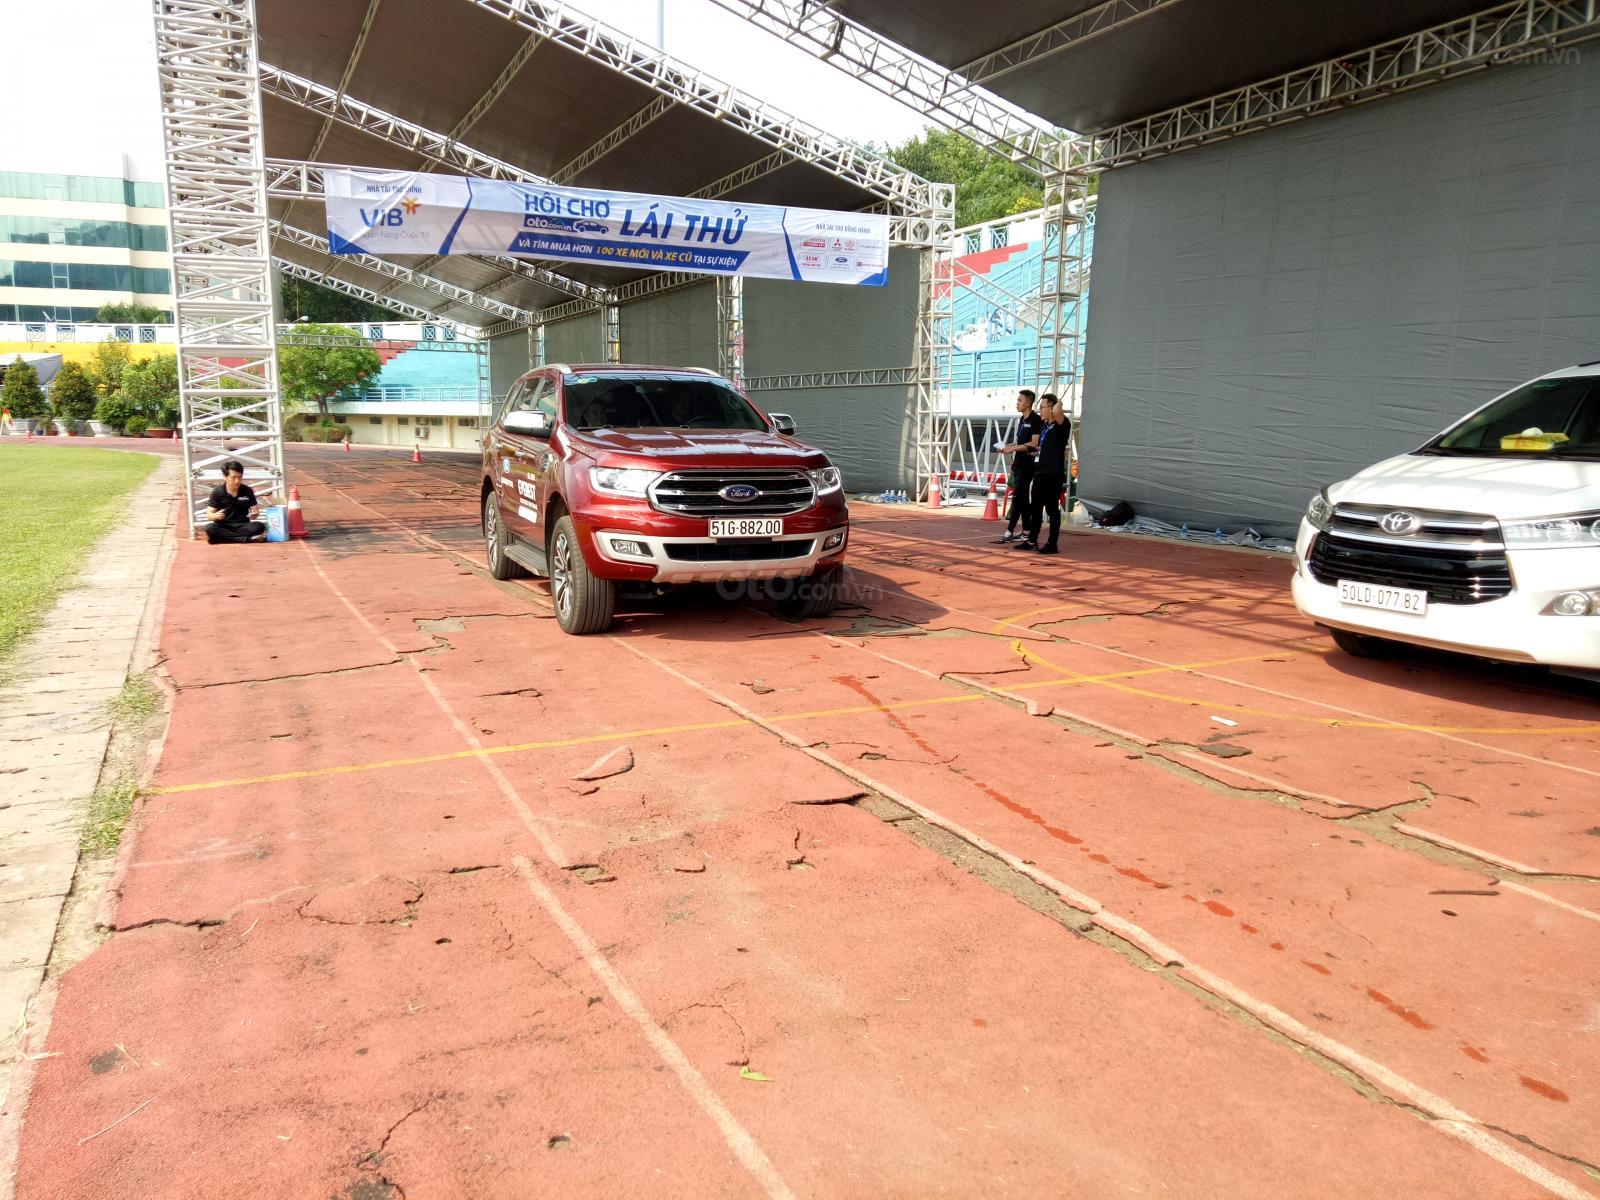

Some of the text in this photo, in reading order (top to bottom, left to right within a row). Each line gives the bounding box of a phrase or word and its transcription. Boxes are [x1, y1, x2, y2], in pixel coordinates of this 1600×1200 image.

[566, 199, 611, 219] CHỢ
[619, 202, 749, 245] LÁI THỬ
[518, 238, 738, 267] VÀ TÌM MUA HƠN 100 XE MỚI VÀ XE CŨ TẠI SỰ KIỆN
[730, 487, 751, 498] Ford
[711, 520, 781, 536] 51G-882.00
